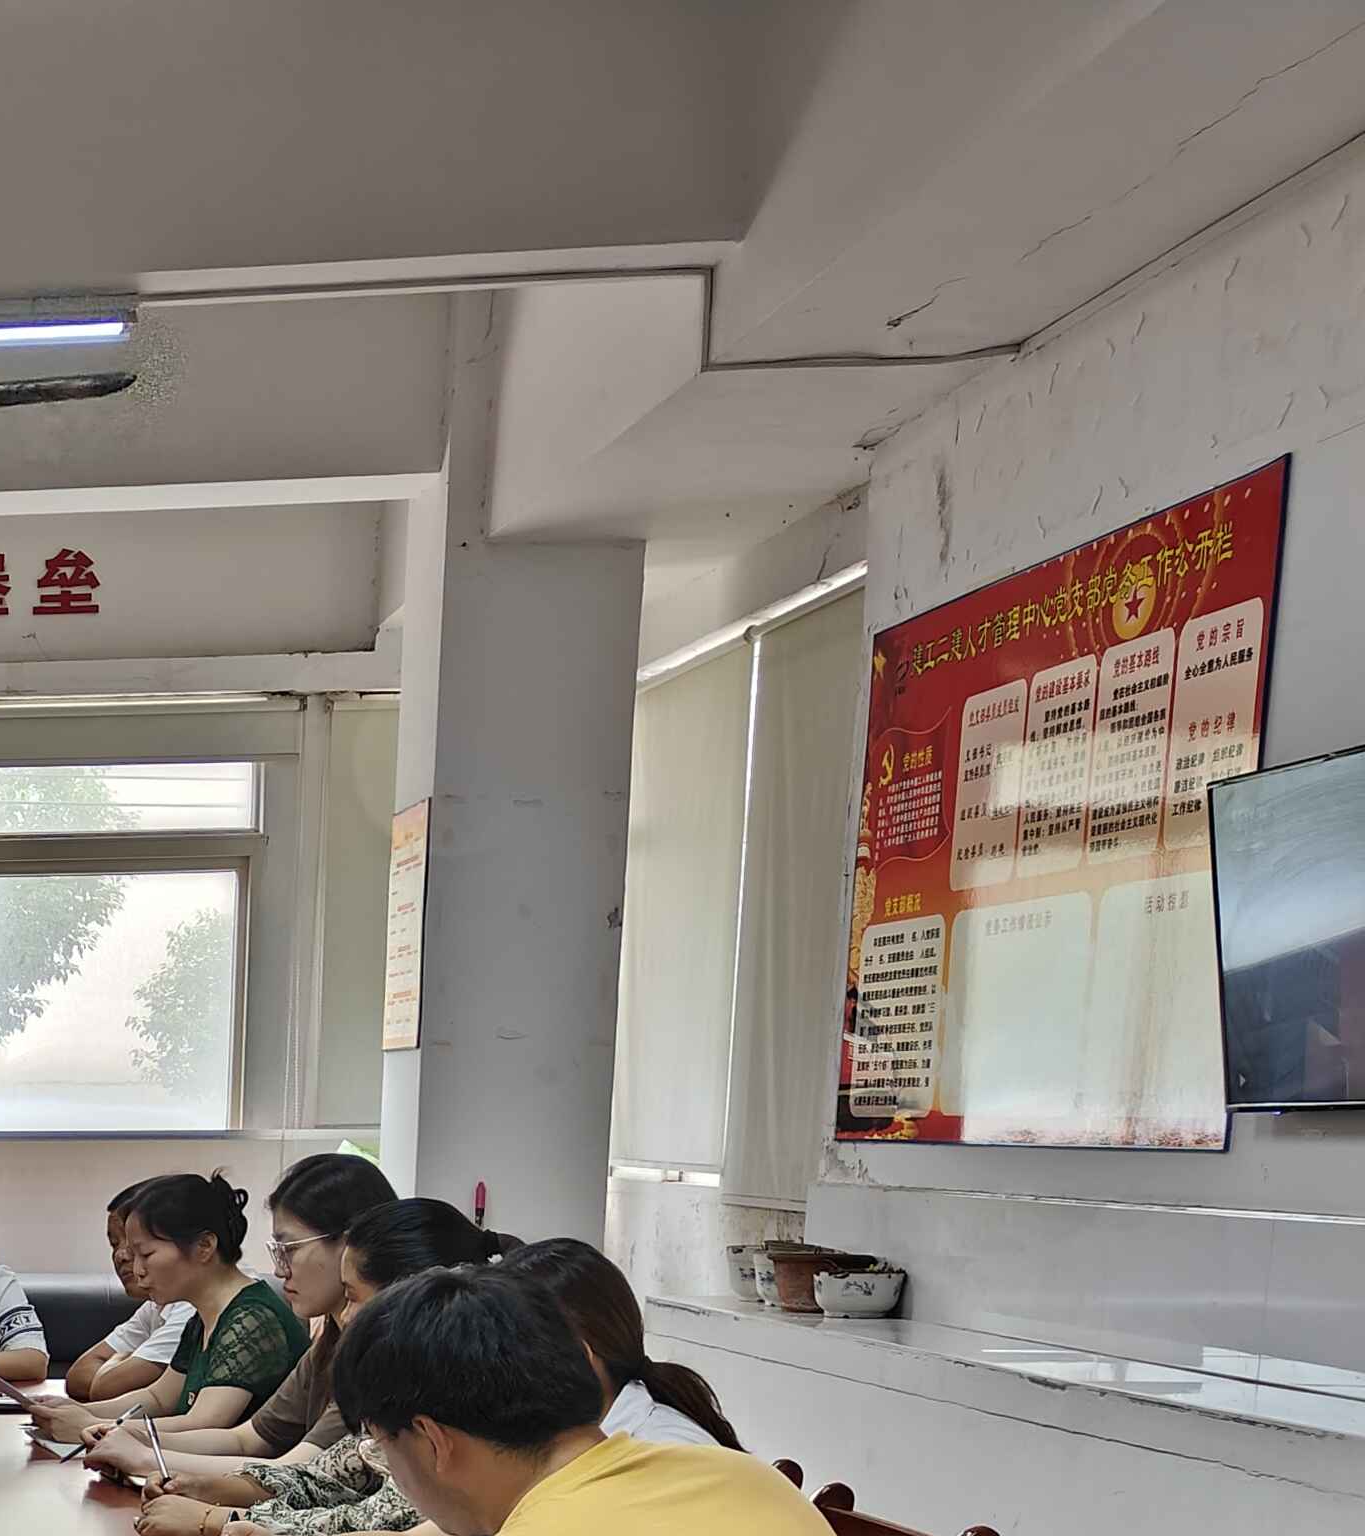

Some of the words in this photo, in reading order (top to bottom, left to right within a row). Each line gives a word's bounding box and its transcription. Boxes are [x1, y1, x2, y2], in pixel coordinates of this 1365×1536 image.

[911, 520, 1234, 677] 建工二建人才管理中心党支部党务工作公开栏
[1195, 617, 1245, 652] 党的宗旨
[1112, 645, 1160, 679] 党的基本路线
[1183, 647, 1254, 681] 全心全意为人民服务
[1034, 669, 1091, 703] 党的建设基本要求
[1187, 708, 1237, 743] 党的纪律
[1171, 799, 1202, 817] 工作纪律
